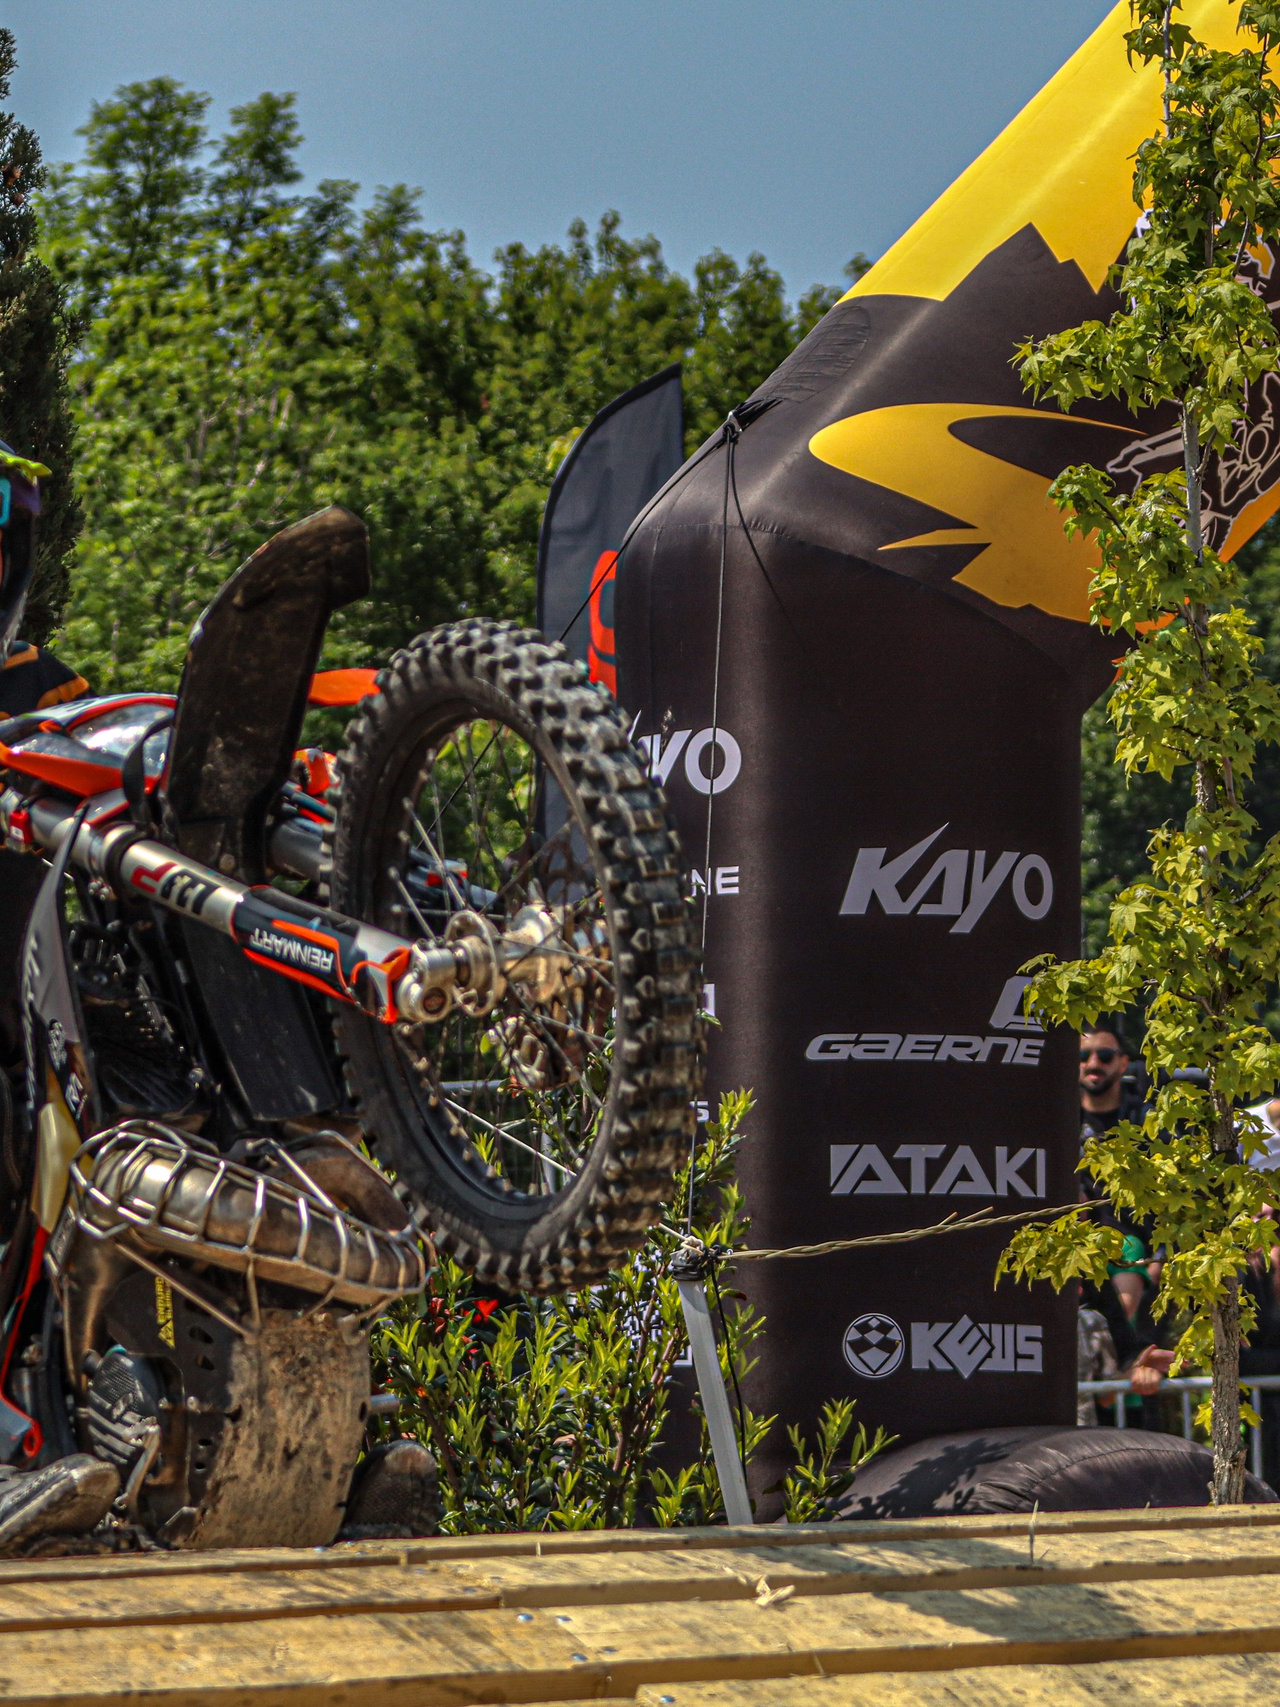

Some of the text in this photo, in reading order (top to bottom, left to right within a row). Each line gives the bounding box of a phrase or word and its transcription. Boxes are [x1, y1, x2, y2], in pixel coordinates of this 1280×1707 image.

[628, 711, 742, 796] YO
[838, 821, 1054, 934] KAYO
[249, 927, 334, 973] REINMART
[805, 1033, 1046, 1066] GAERNE
[829, 1143, 1047, 1199] ATAKI
[910, 1313, 1044, 1380] KEWS
